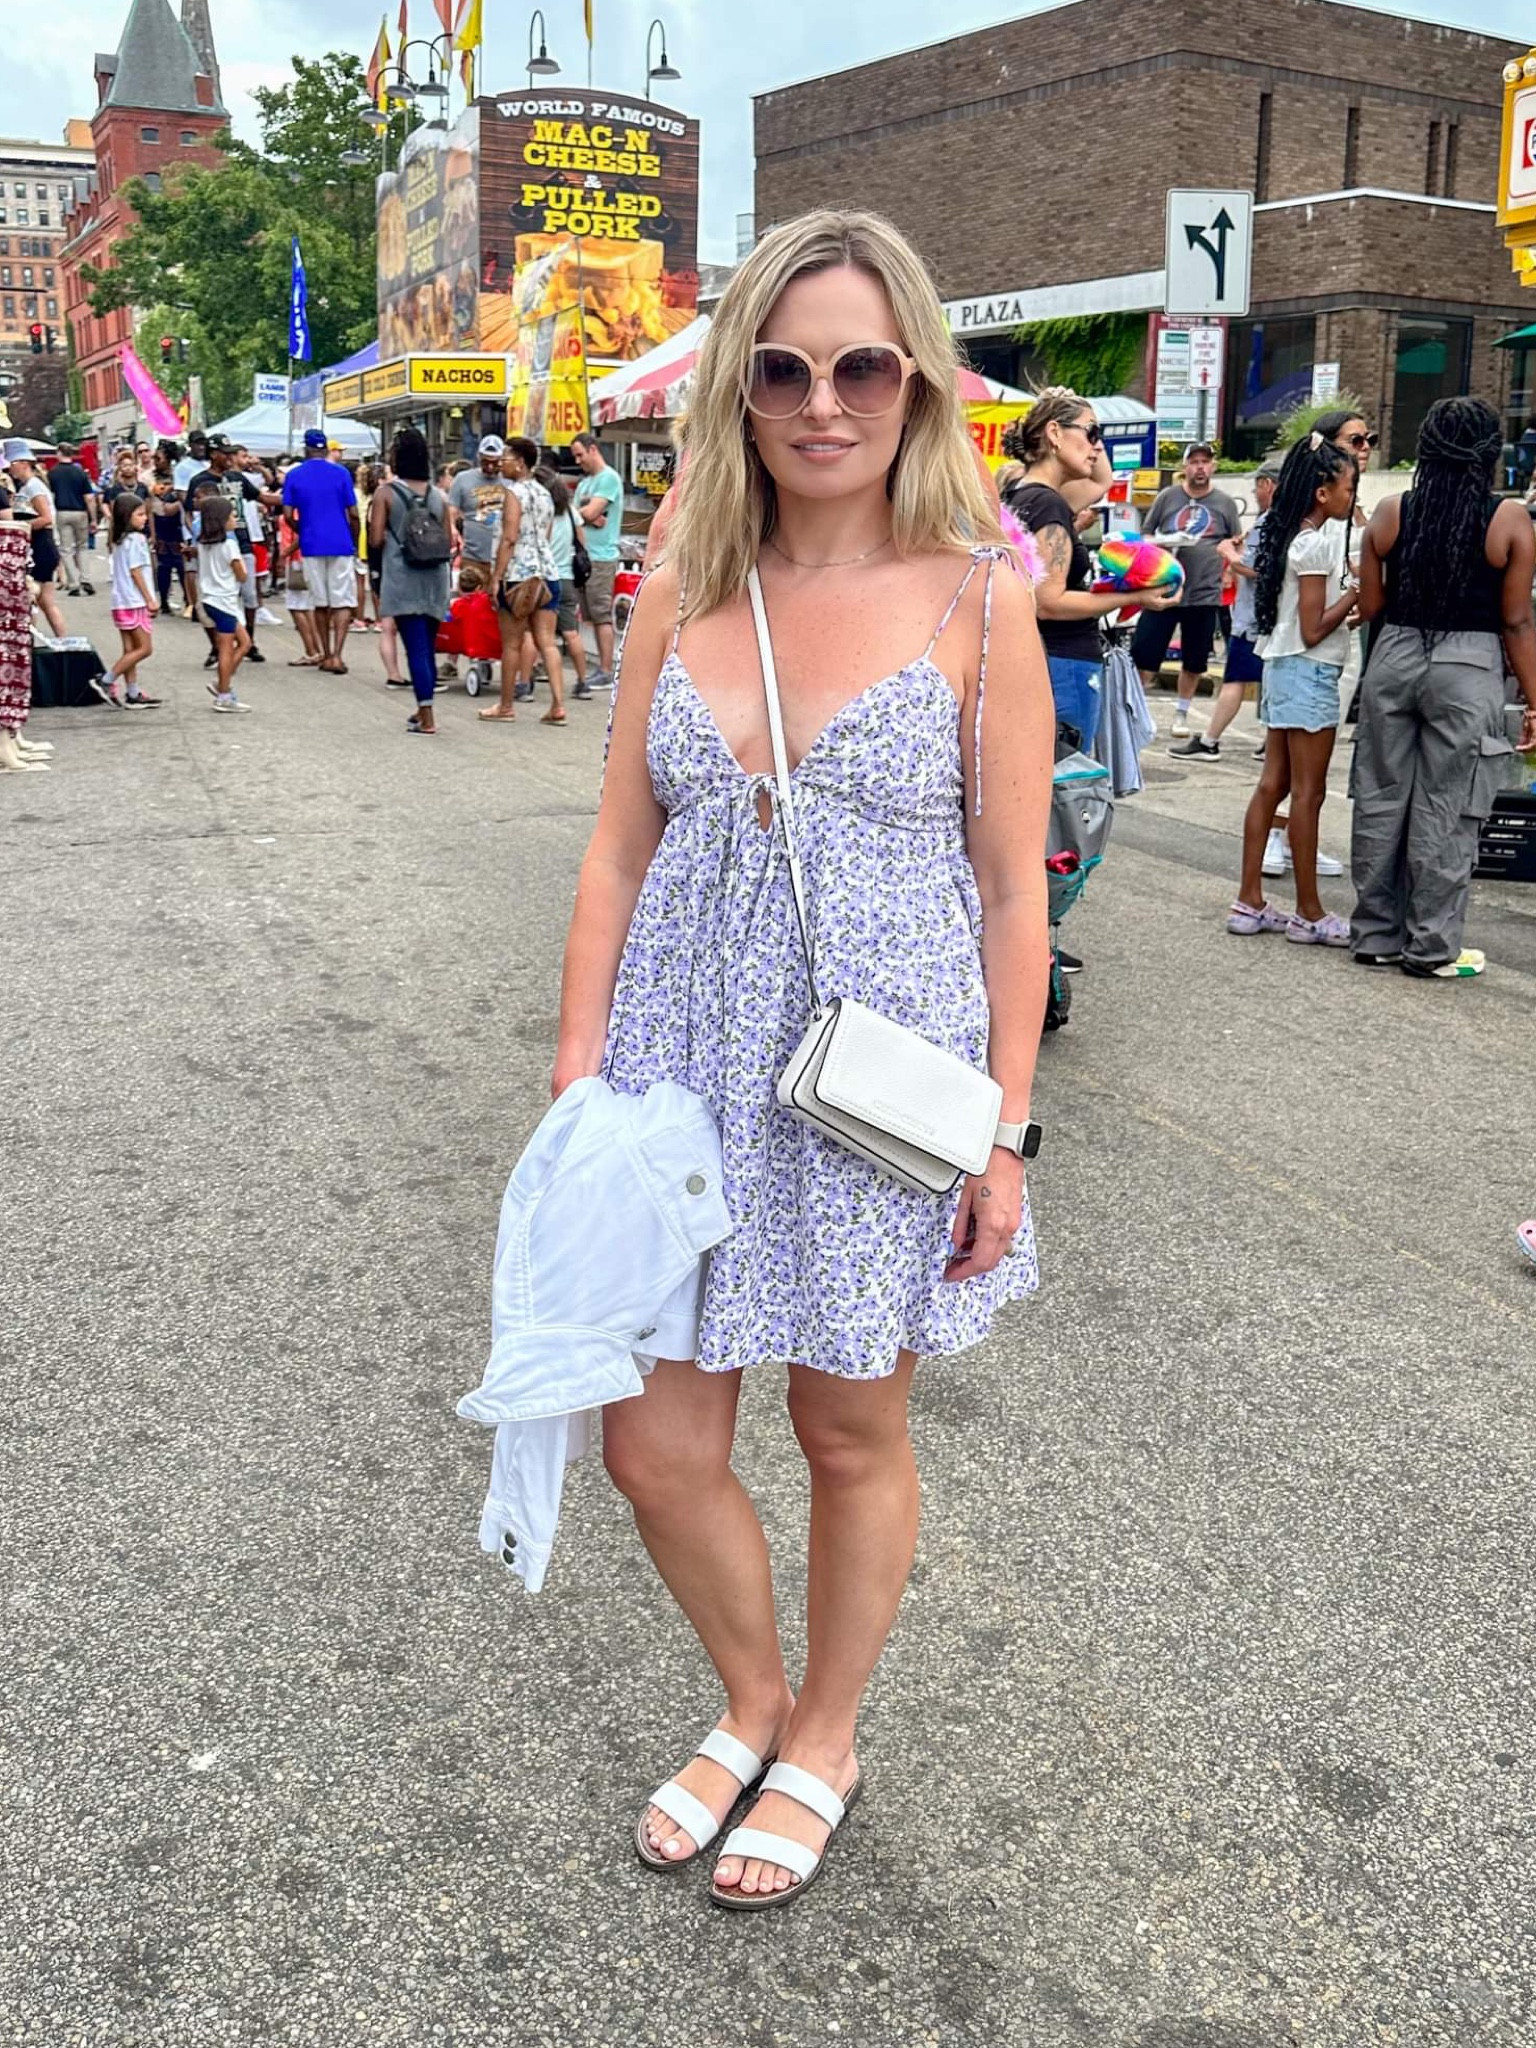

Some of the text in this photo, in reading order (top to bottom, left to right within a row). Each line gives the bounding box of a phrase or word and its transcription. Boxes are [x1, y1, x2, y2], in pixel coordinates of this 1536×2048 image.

[496, 100, 686, 137] WORLD FAMOUS
[532, 119, 652, 153] MAC-N
[523, 142, 662, 177] CHEESE
[584, 174, 602, 189] &
[521, 183, 663, 218] PULLED
[543, 209, 641, 240] PORK
[961, 299, 1025, 327] PLAZA
[422, 369, 496, 384] NACHOS
[546, 401, 584, 432] RIES
